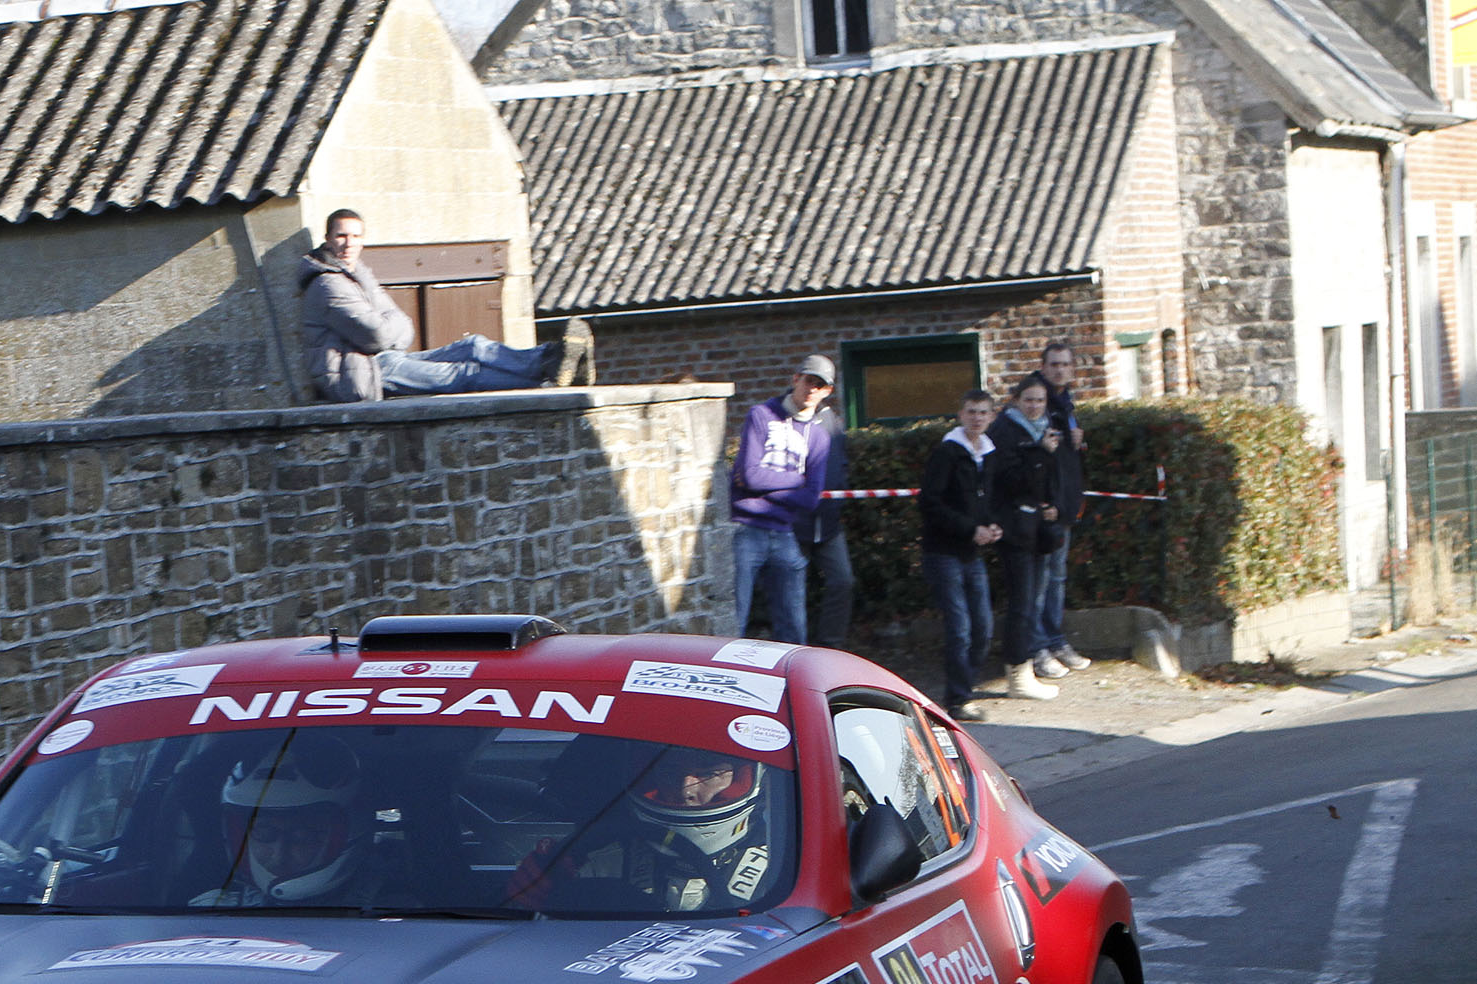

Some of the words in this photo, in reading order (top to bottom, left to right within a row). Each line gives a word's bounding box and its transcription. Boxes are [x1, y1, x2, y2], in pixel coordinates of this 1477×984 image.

[188, 688, 616, 727] NISSAN
[242, 951, 320, 964] HUY
[563, 922, 691, 975] BANDEN
